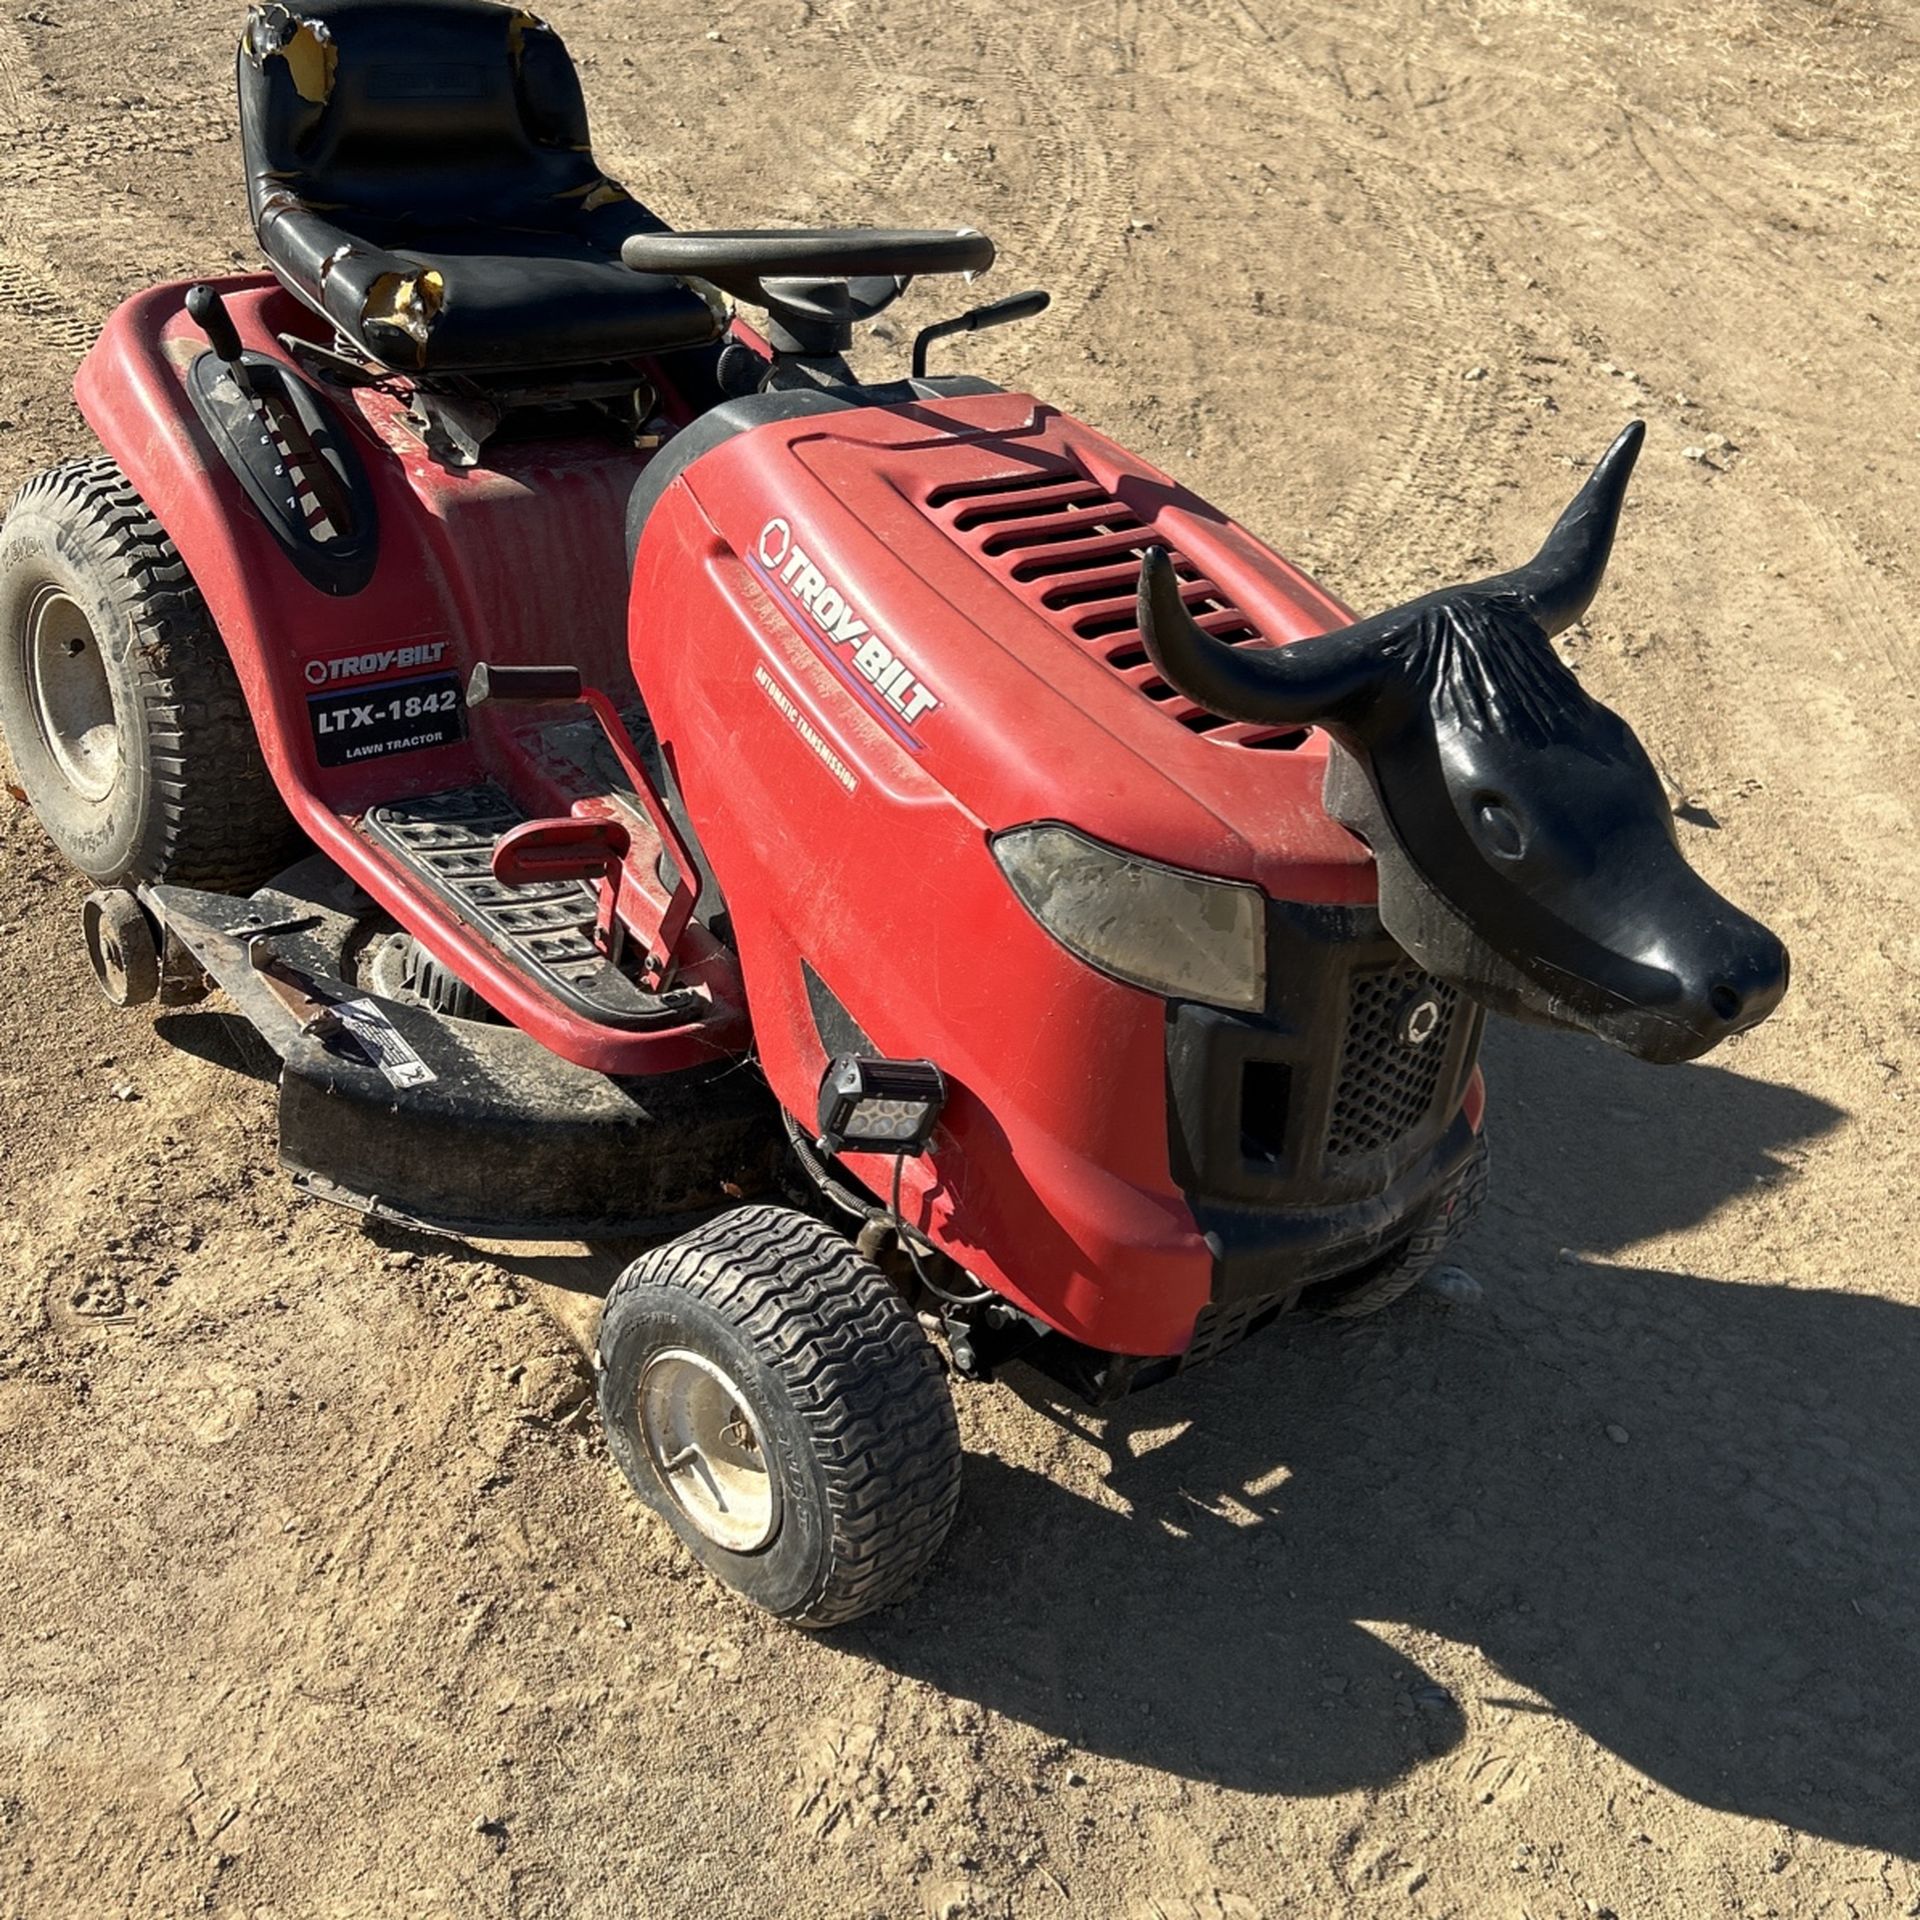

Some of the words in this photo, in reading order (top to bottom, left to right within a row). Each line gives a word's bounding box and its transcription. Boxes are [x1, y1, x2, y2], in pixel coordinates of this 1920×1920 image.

[779, 544, 939, 725] TROY-BILT
[327, 642, 446, 680] TROY-BILT
[318, 690, 457, 734] LTX-1842
[755, 666, 799, 722] AUTOMATIC
[796, 715, 858, 792] TRANSMISSION
[346, 743, 384, 759] LAWN
[386, 731, 443, 751] TRACTOR
